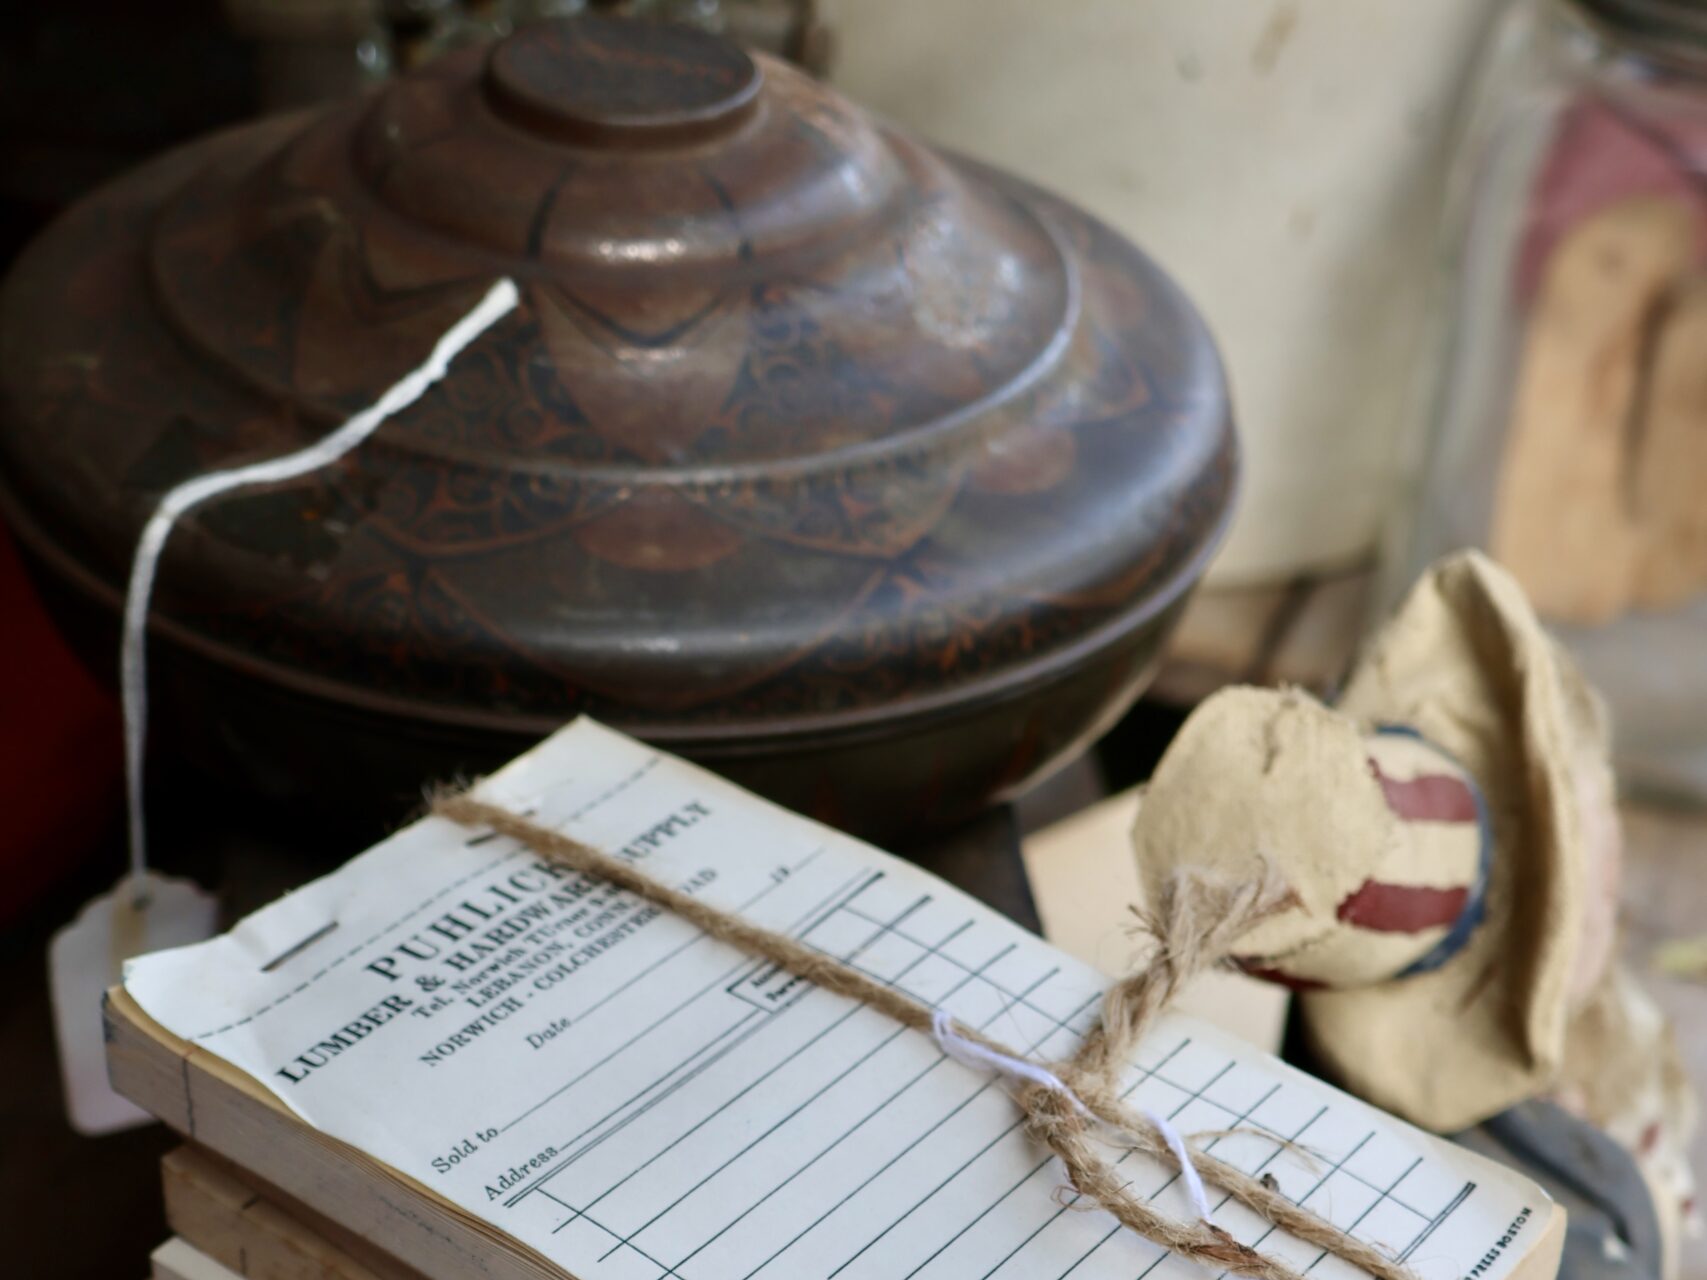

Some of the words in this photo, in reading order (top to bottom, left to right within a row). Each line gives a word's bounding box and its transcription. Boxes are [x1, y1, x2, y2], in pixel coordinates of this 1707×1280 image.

[411, 996, 454, 1020] Tel.
[451, 947, 526, 995] Norwich
[465, 938, 575, 1009] LEBANON,
[275, 993, 414, 1084] LUMBER
[414, 974, 446, 993] &
[418, 996, 525, 1067] NORWICH
[525, 1016, 571, 1050] Date
[431, 1139, 478, 1174] Sold
[475, 1127, 499, 1143] to
[484, 1146, 559, 1201] Address
[1471, 1248, 1501, 1278] PRESS
[1496, 1206, 1533, 1249] BOSTON
